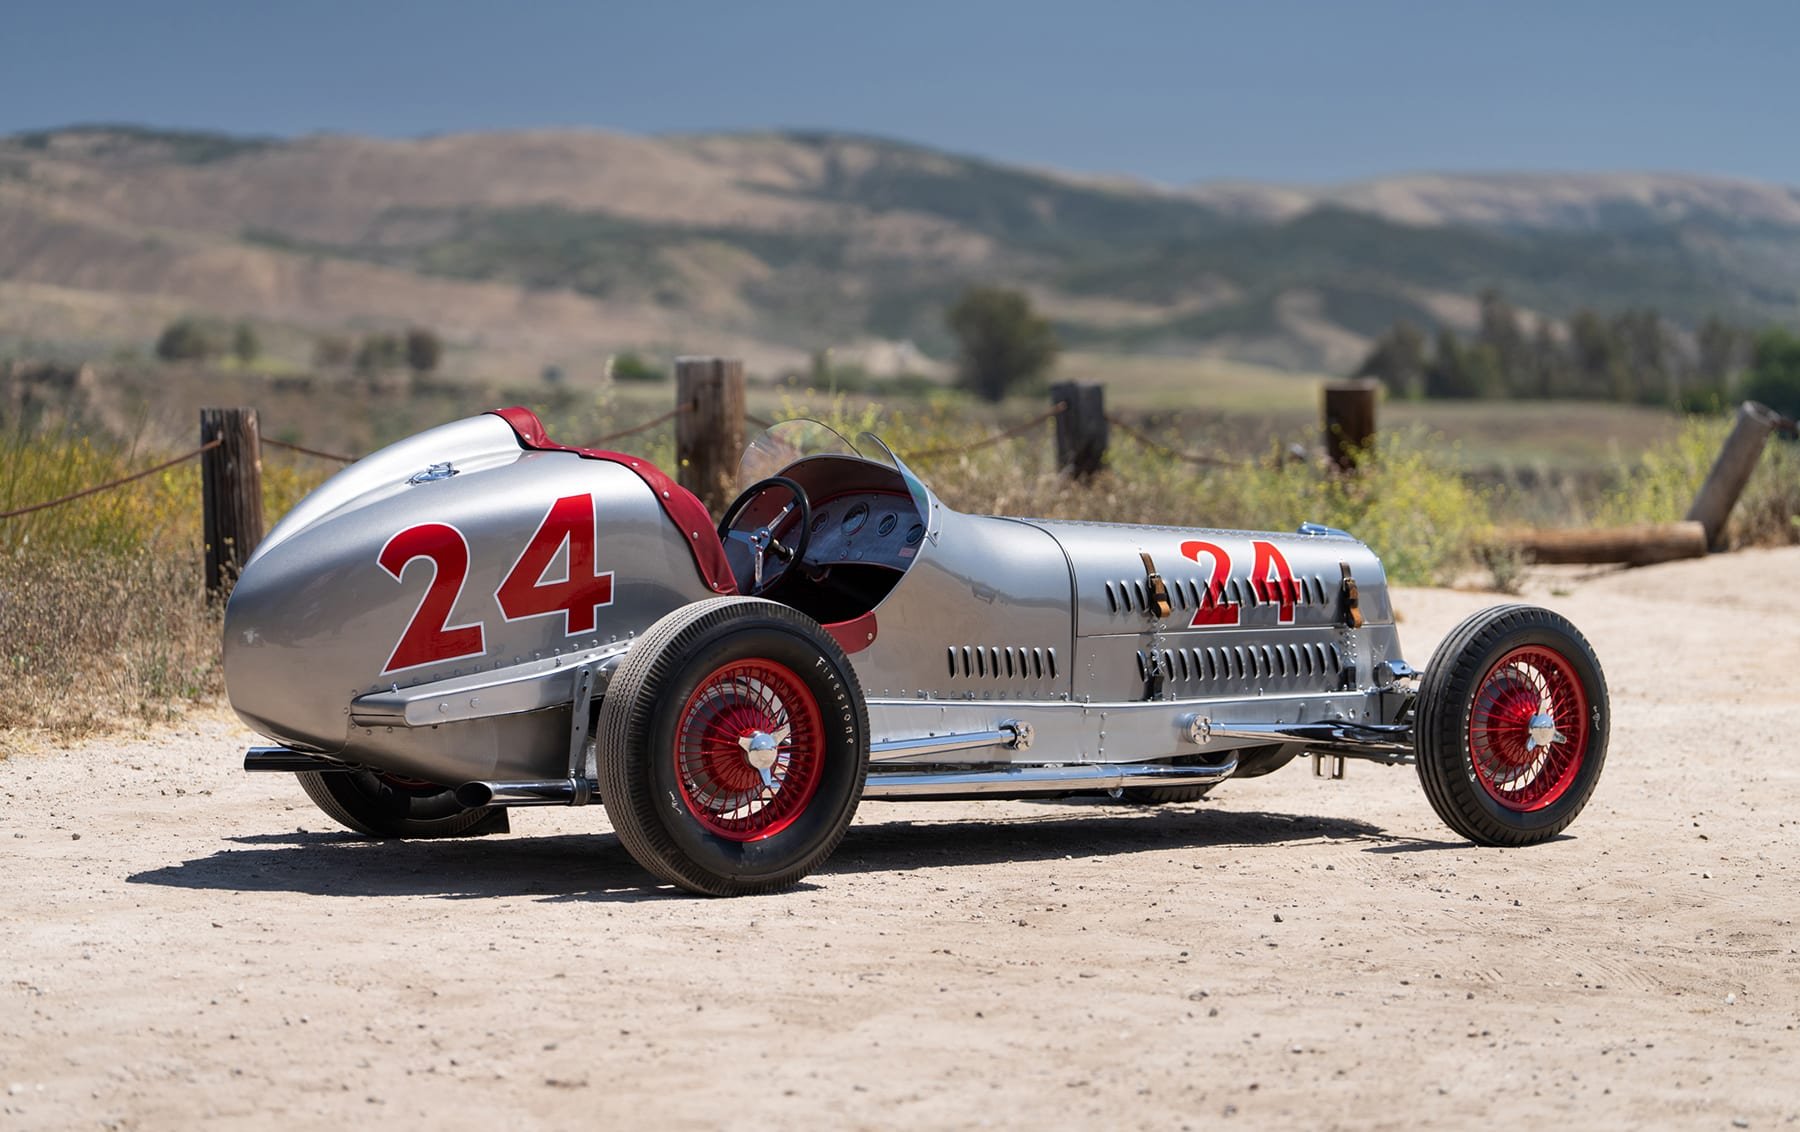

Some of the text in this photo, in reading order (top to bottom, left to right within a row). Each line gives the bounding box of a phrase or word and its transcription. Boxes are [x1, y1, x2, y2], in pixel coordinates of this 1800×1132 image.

[376, 493, 615, 677] 24
[1179, 539, 1303, 628] 24
[815, 656, 854, 745] Firestone
